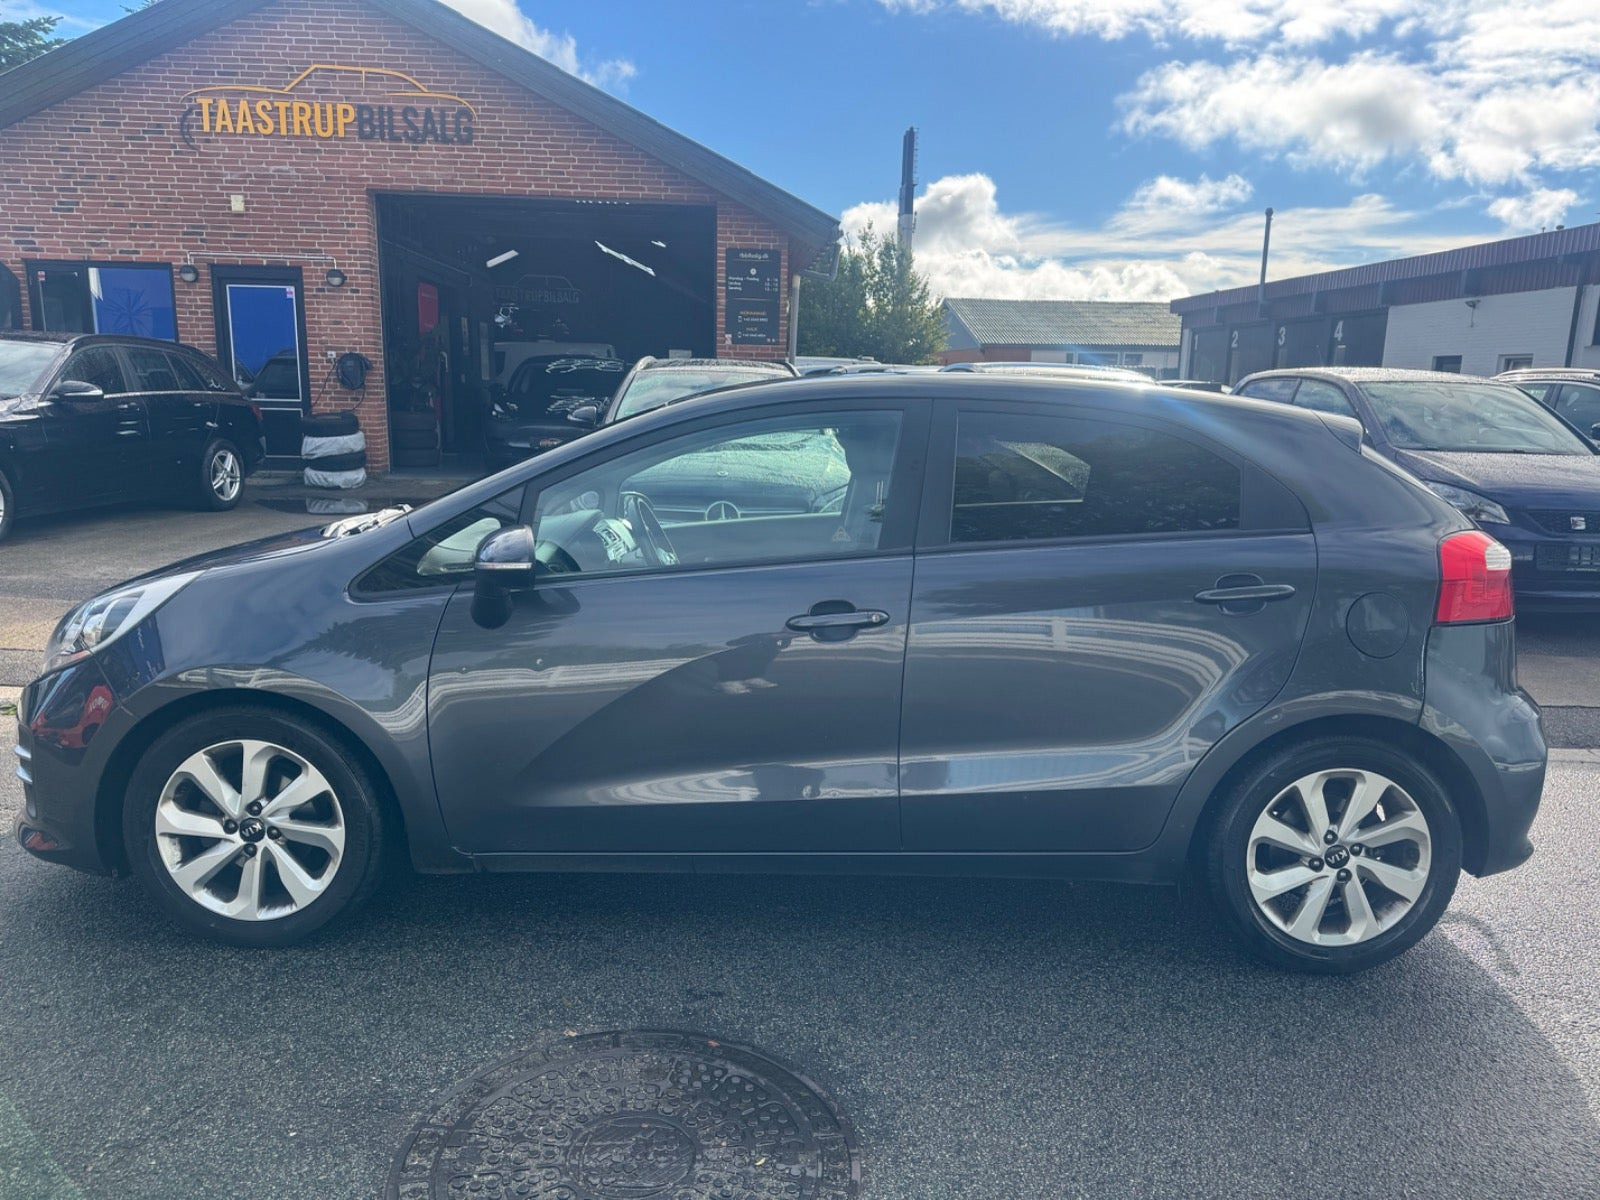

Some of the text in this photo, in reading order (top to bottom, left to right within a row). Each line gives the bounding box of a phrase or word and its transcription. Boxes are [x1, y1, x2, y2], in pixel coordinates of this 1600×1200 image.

[1231, 330, 1239, 348] 2
[1278, 326, 1286, 346] 3
[1334, 320, 1344, 341] 4
[241, 822, 262, 837] KIA
[1327, 849, 1348, 864] KIA
